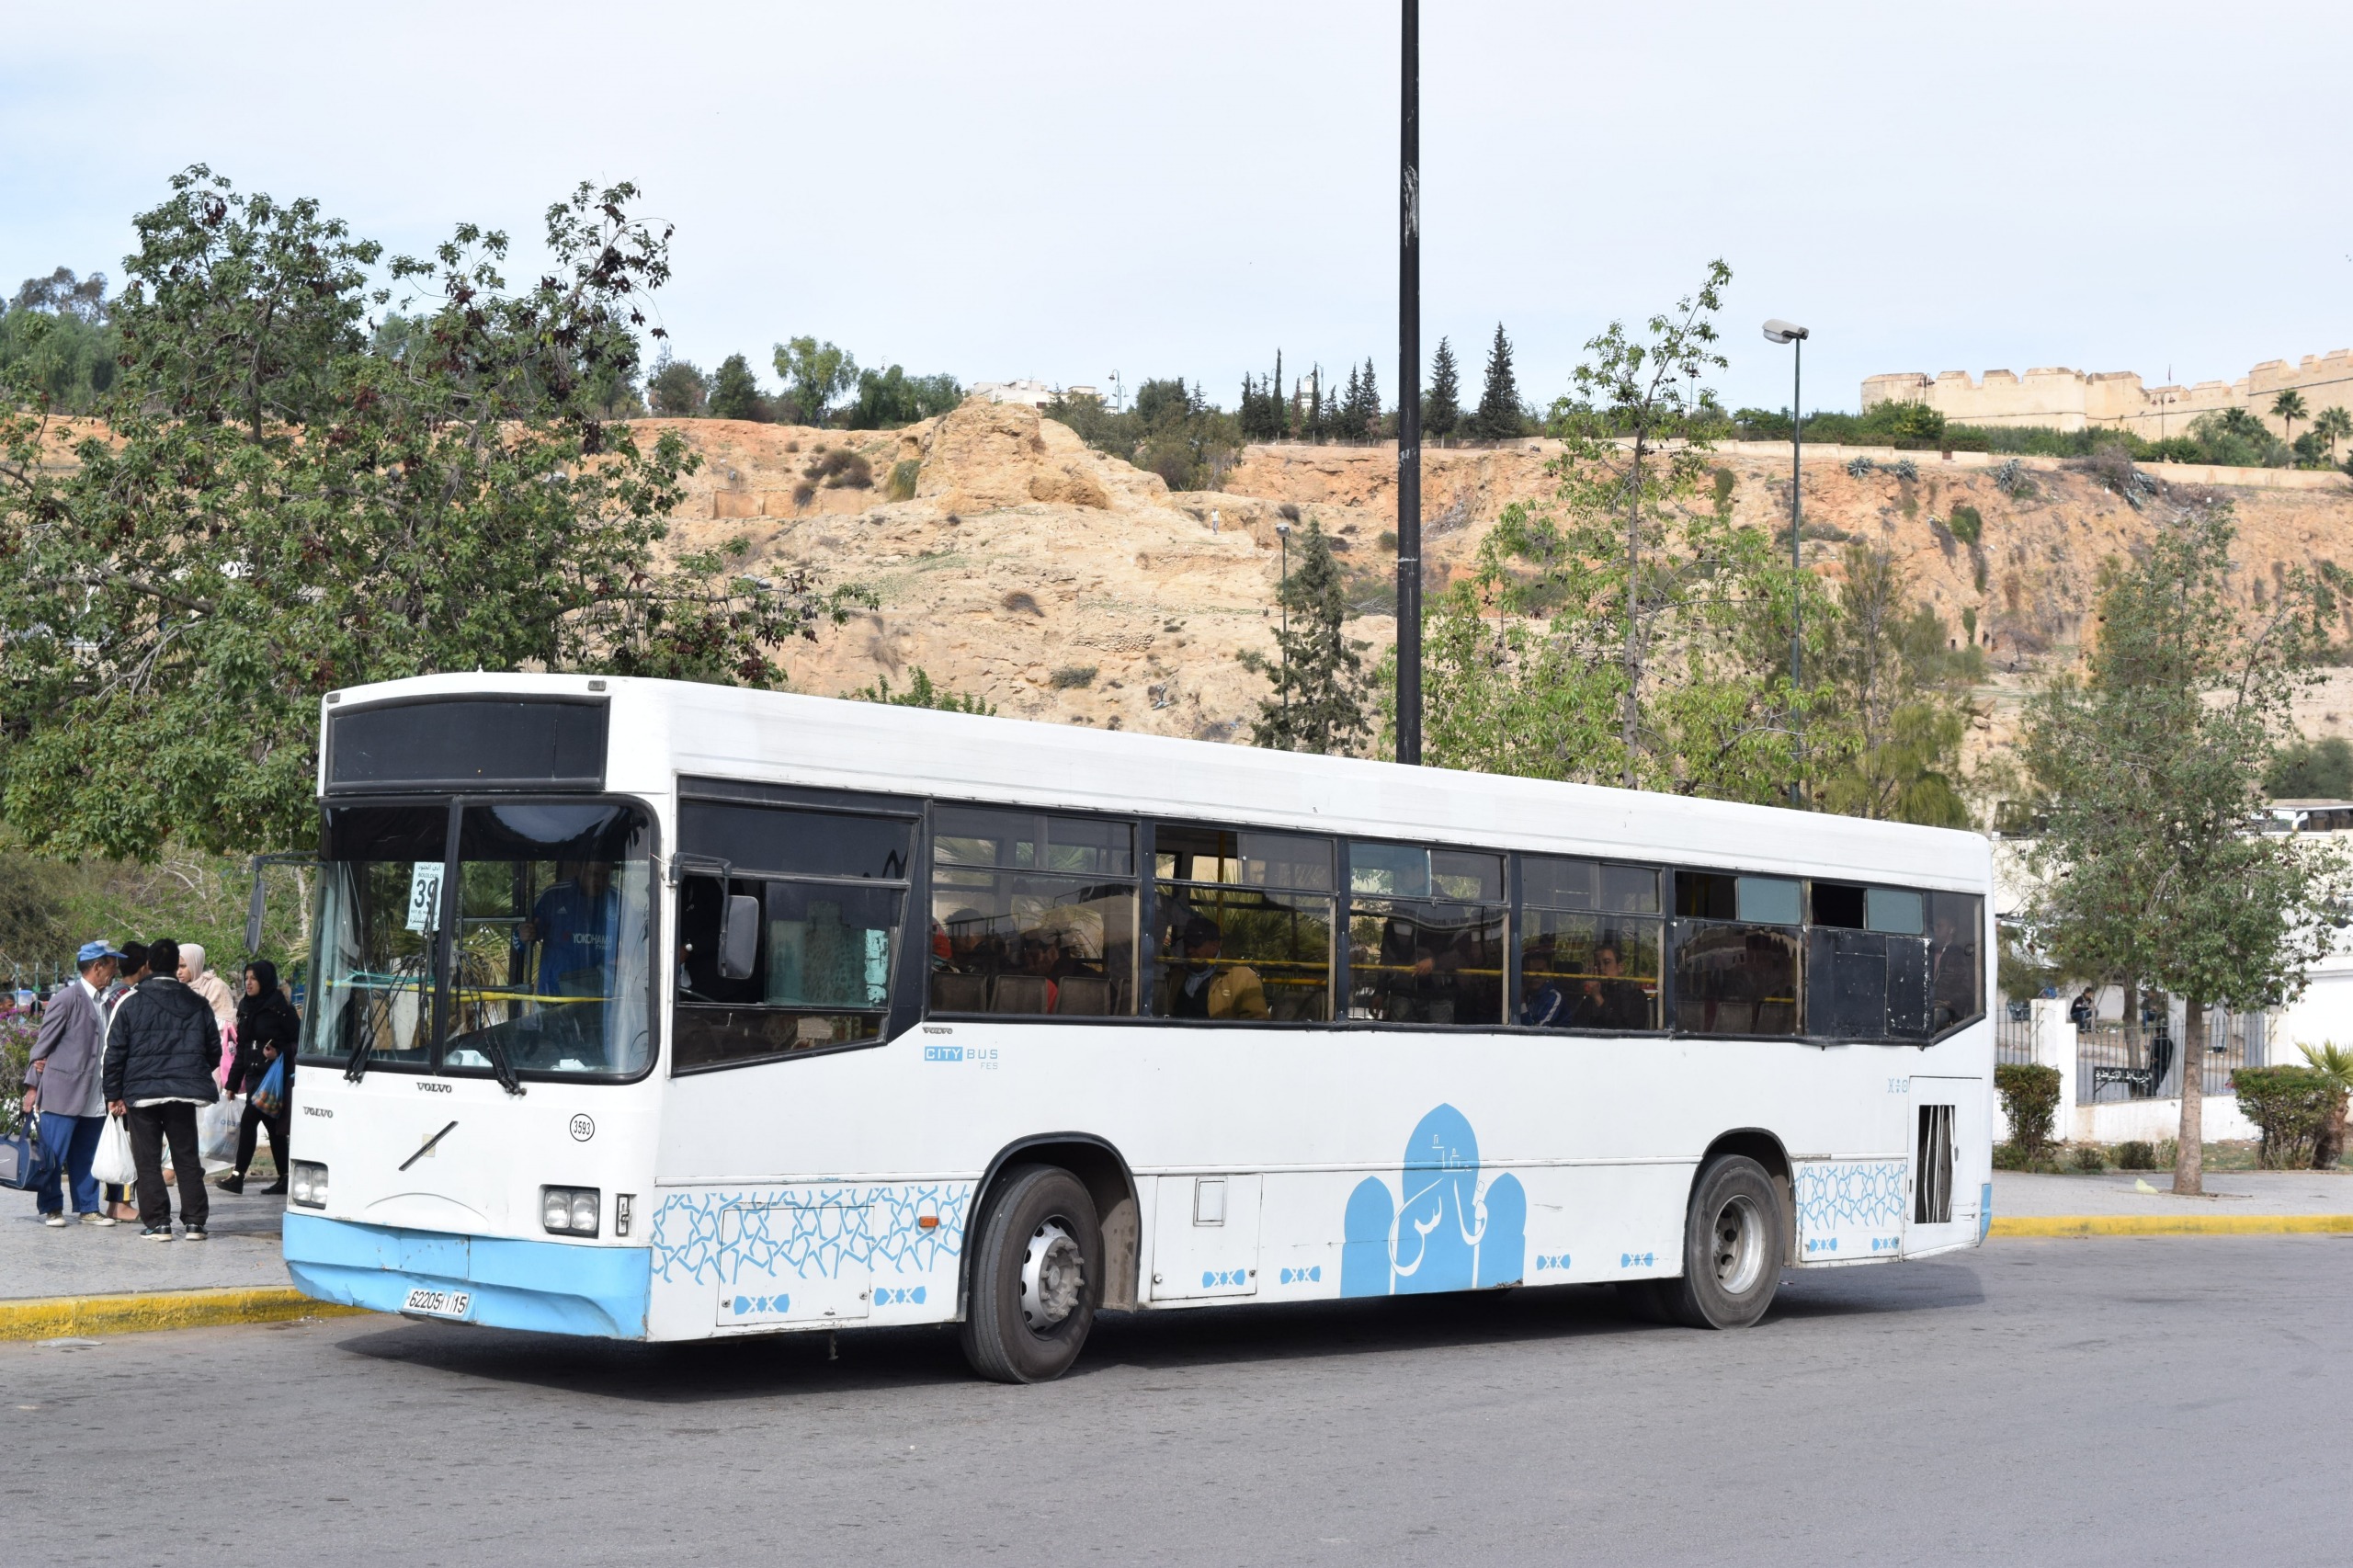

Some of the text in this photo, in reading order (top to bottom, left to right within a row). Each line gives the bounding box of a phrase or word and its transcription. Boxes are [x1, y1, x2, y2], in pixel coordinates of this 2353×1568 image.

[573, 933, 612, 946] YOKOHAMA
[922, 1026, 953, 1035] VOLVO
[926, 1048, 998, 1060] CITY BUS
[980, 1062, 998, 1070] FES
[416, 1081, 452, 1094] VOLVO
[302, 1106, 334, 1119] VOLVO
[574, 1119, 591, 1136] 3593
[409, 1290, 443, 1311] 62205
